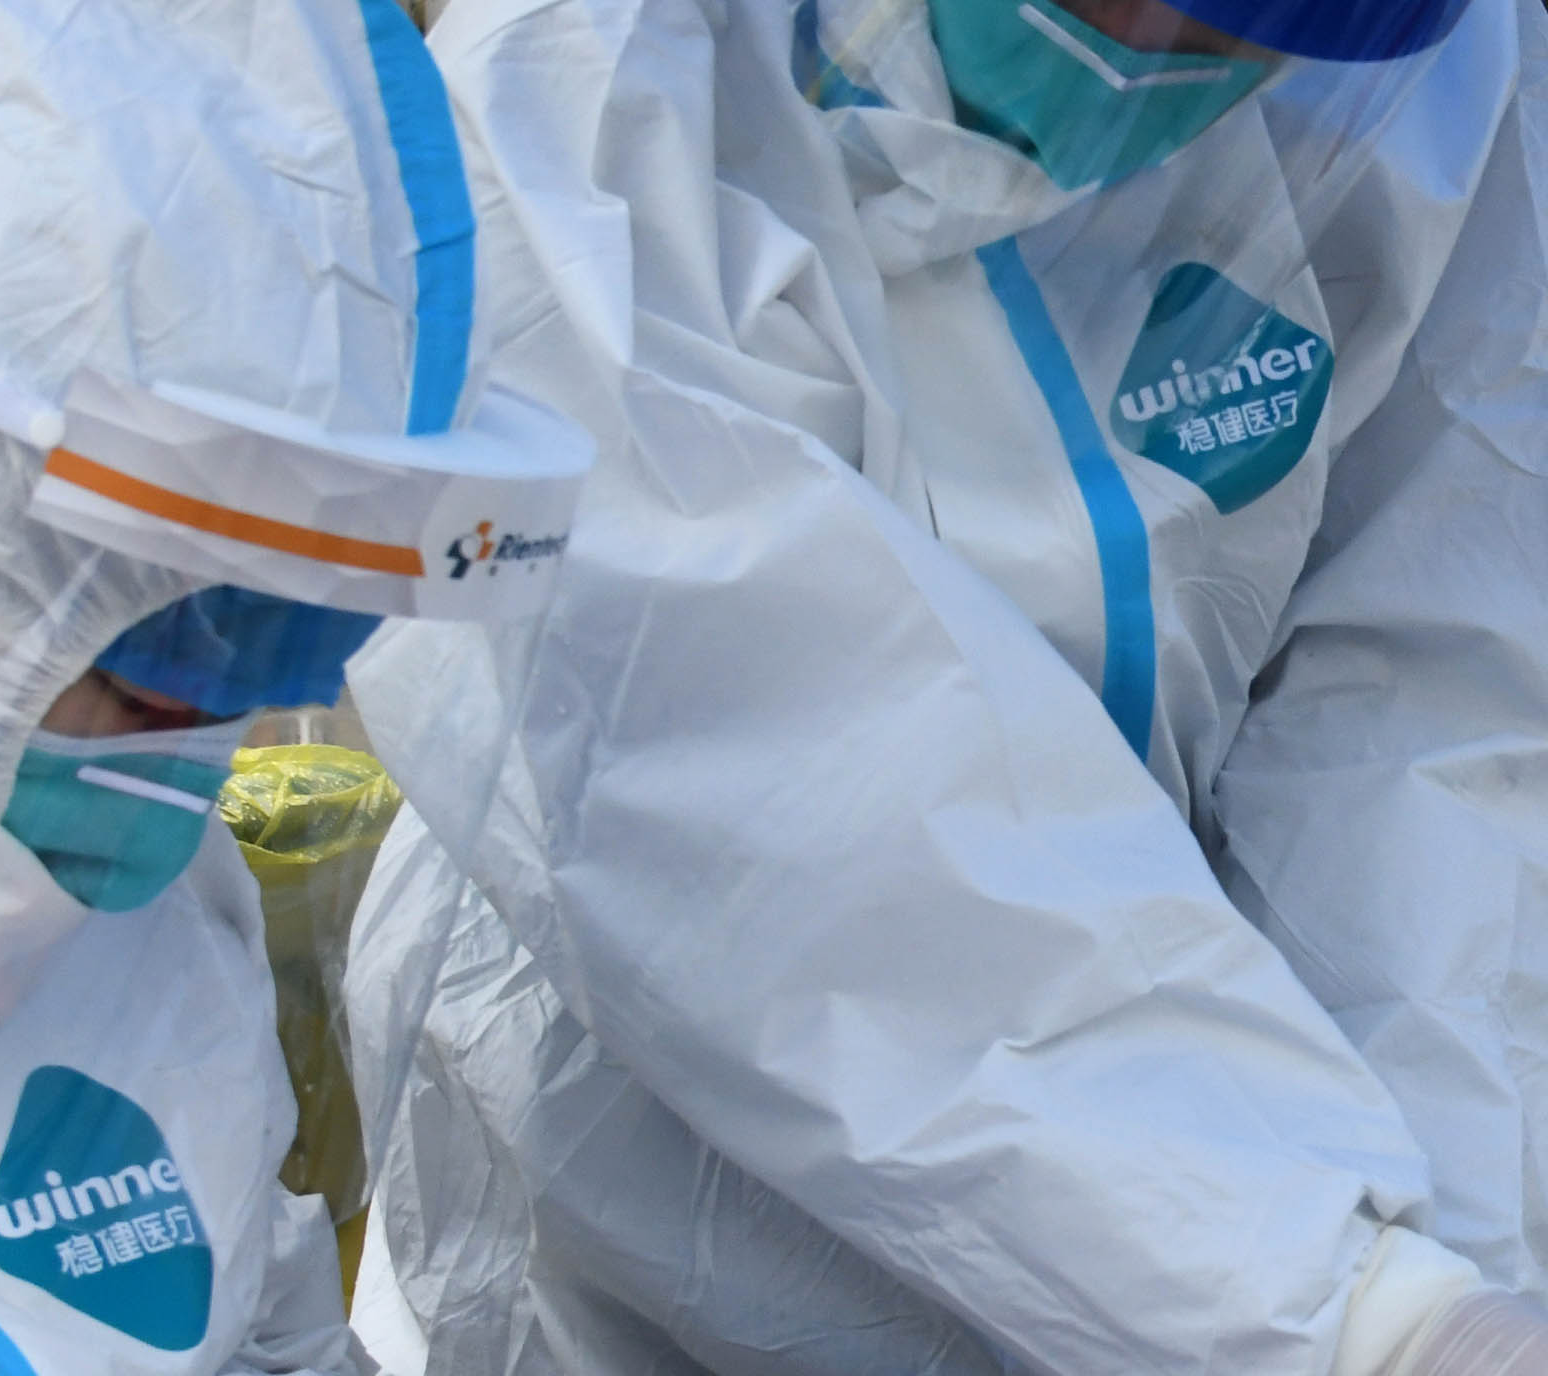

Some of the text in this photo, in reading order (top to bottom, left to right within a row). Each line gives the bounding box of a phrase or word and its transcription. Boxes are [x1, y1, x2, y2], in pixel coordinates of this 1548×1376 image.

[1120, 337, 1316, 422] winner
[1174, 390, 1298, 455] 稳健医疗
[54, 1204, 197, 1278] 稳健医疗
